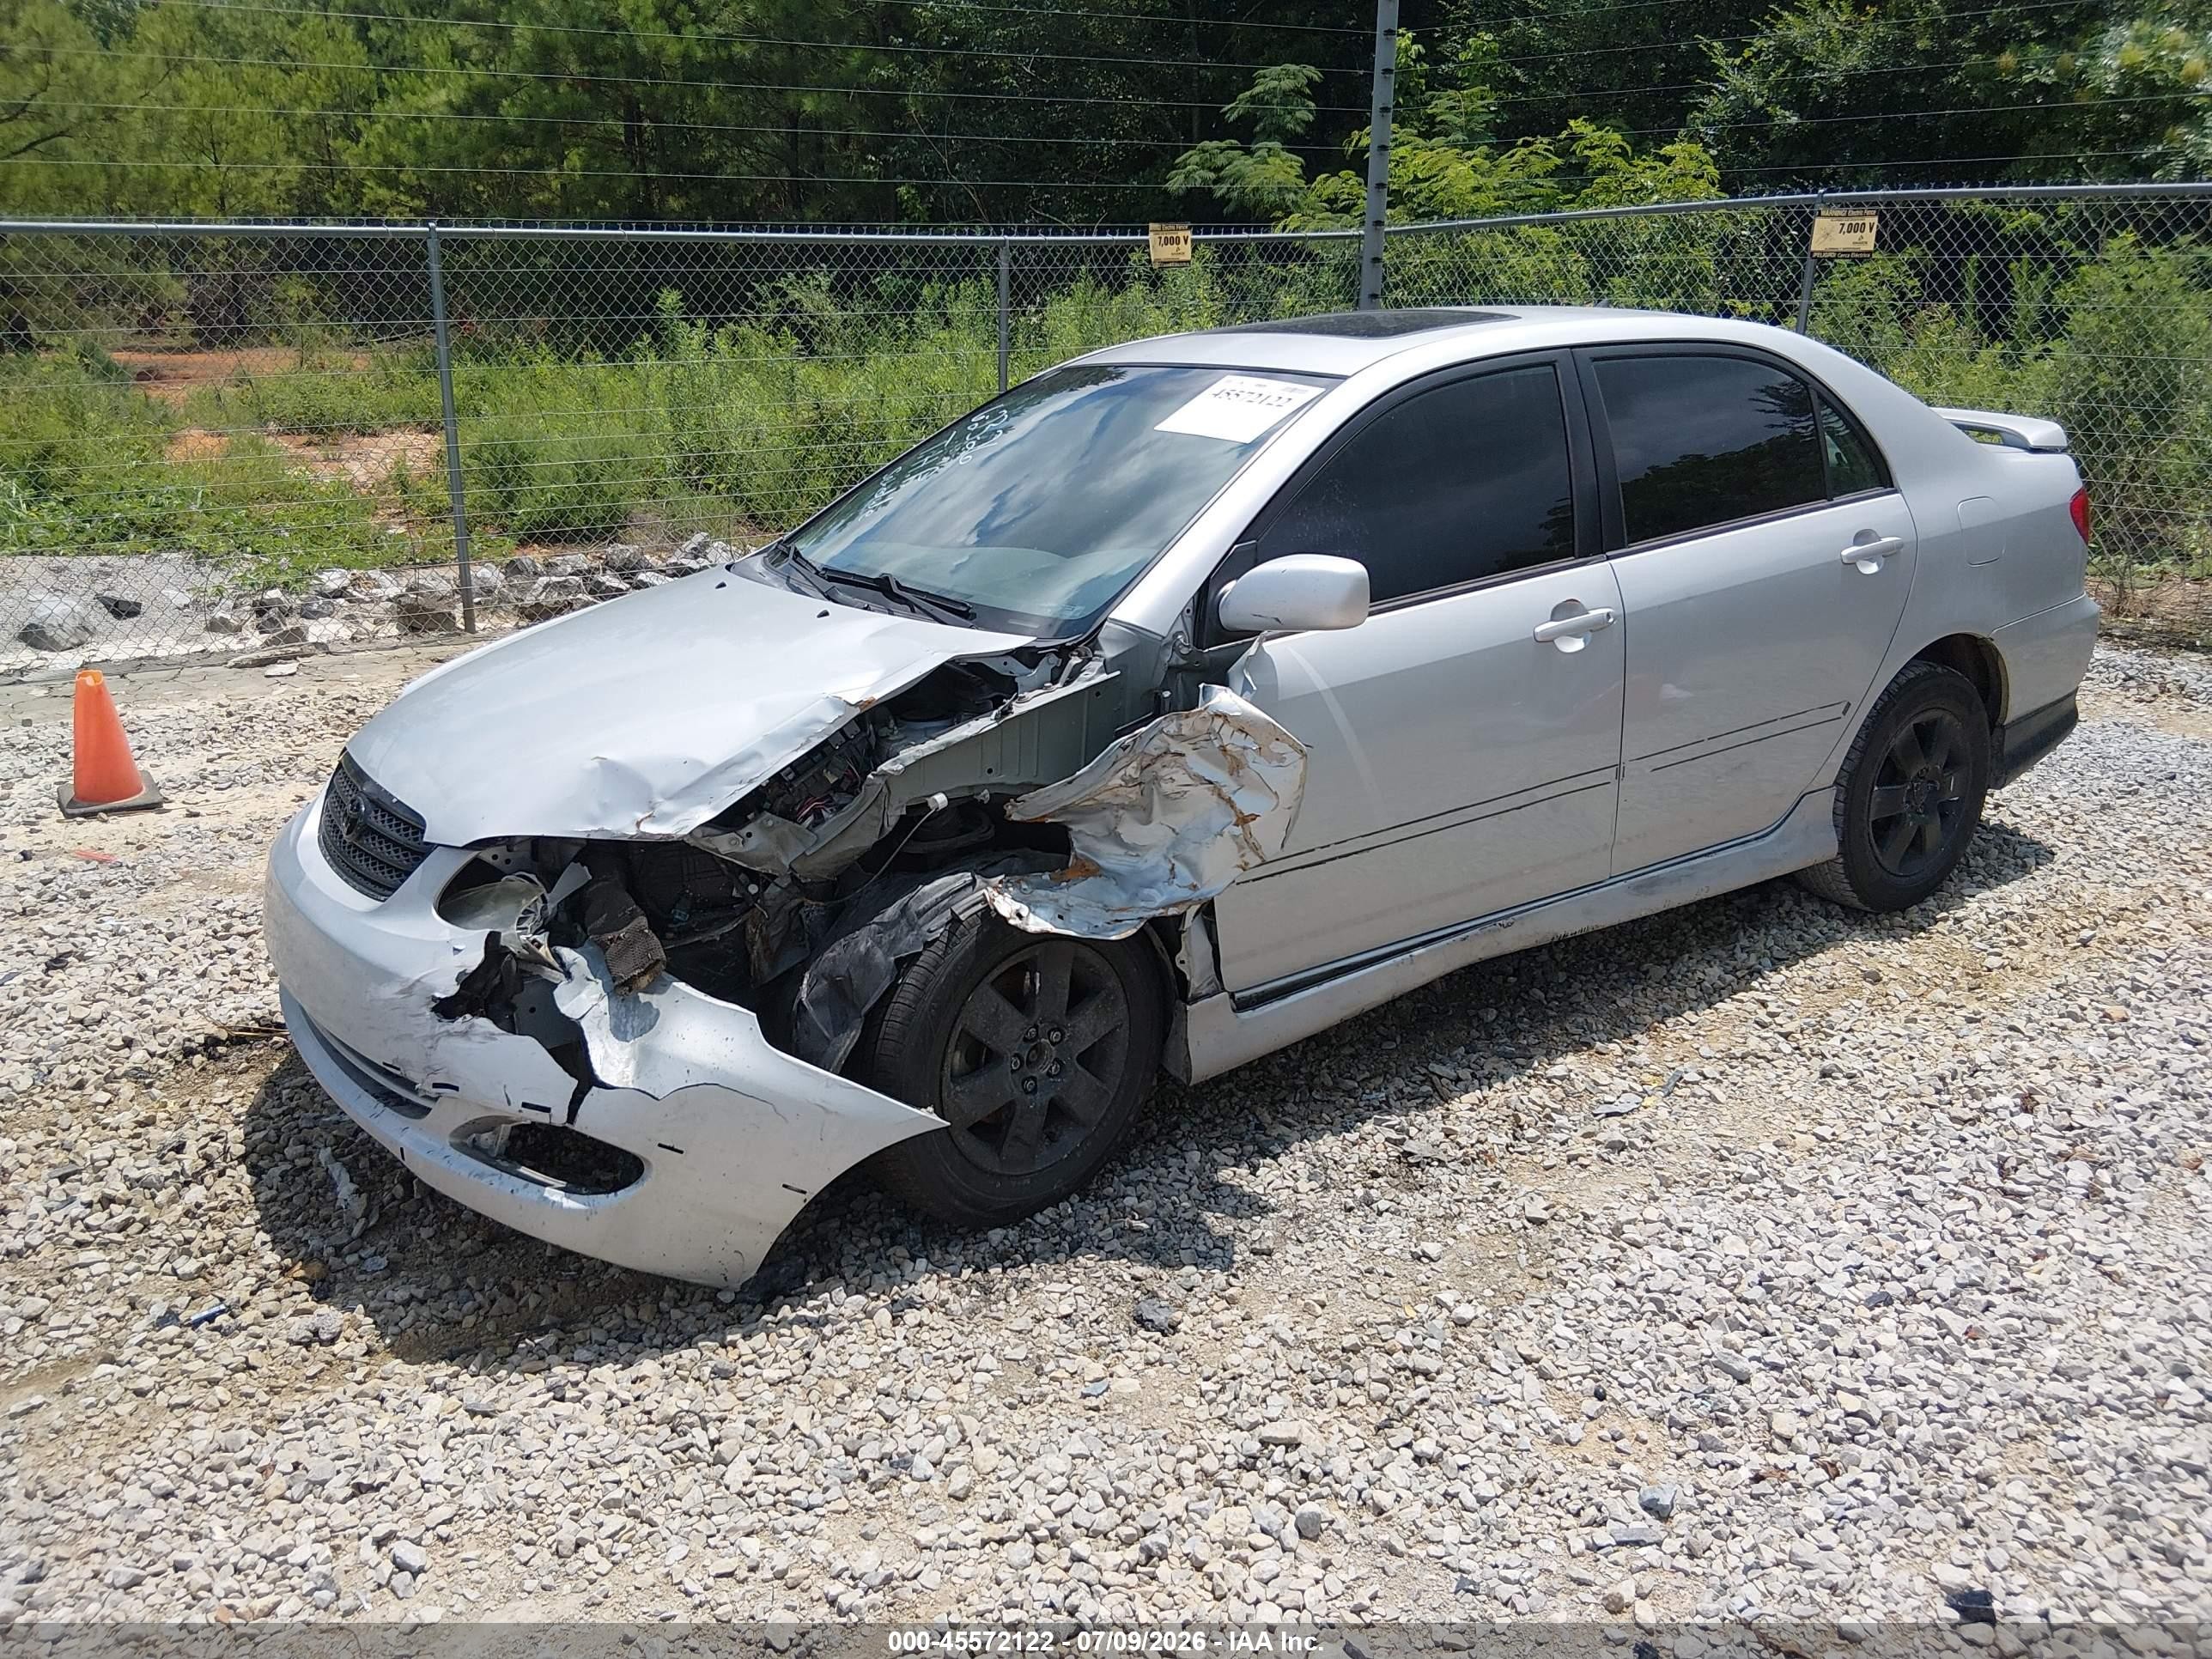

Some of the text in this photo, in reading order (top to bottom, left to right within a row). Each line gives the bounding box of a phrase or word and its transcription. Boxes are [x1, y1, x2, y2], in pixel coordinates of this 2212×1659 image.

[1838, 222, 1875, 235] 7,000 V
[1158, 235, 1189, 247] 7,000 V
[1212, 389, 1292, 407] 45572122
